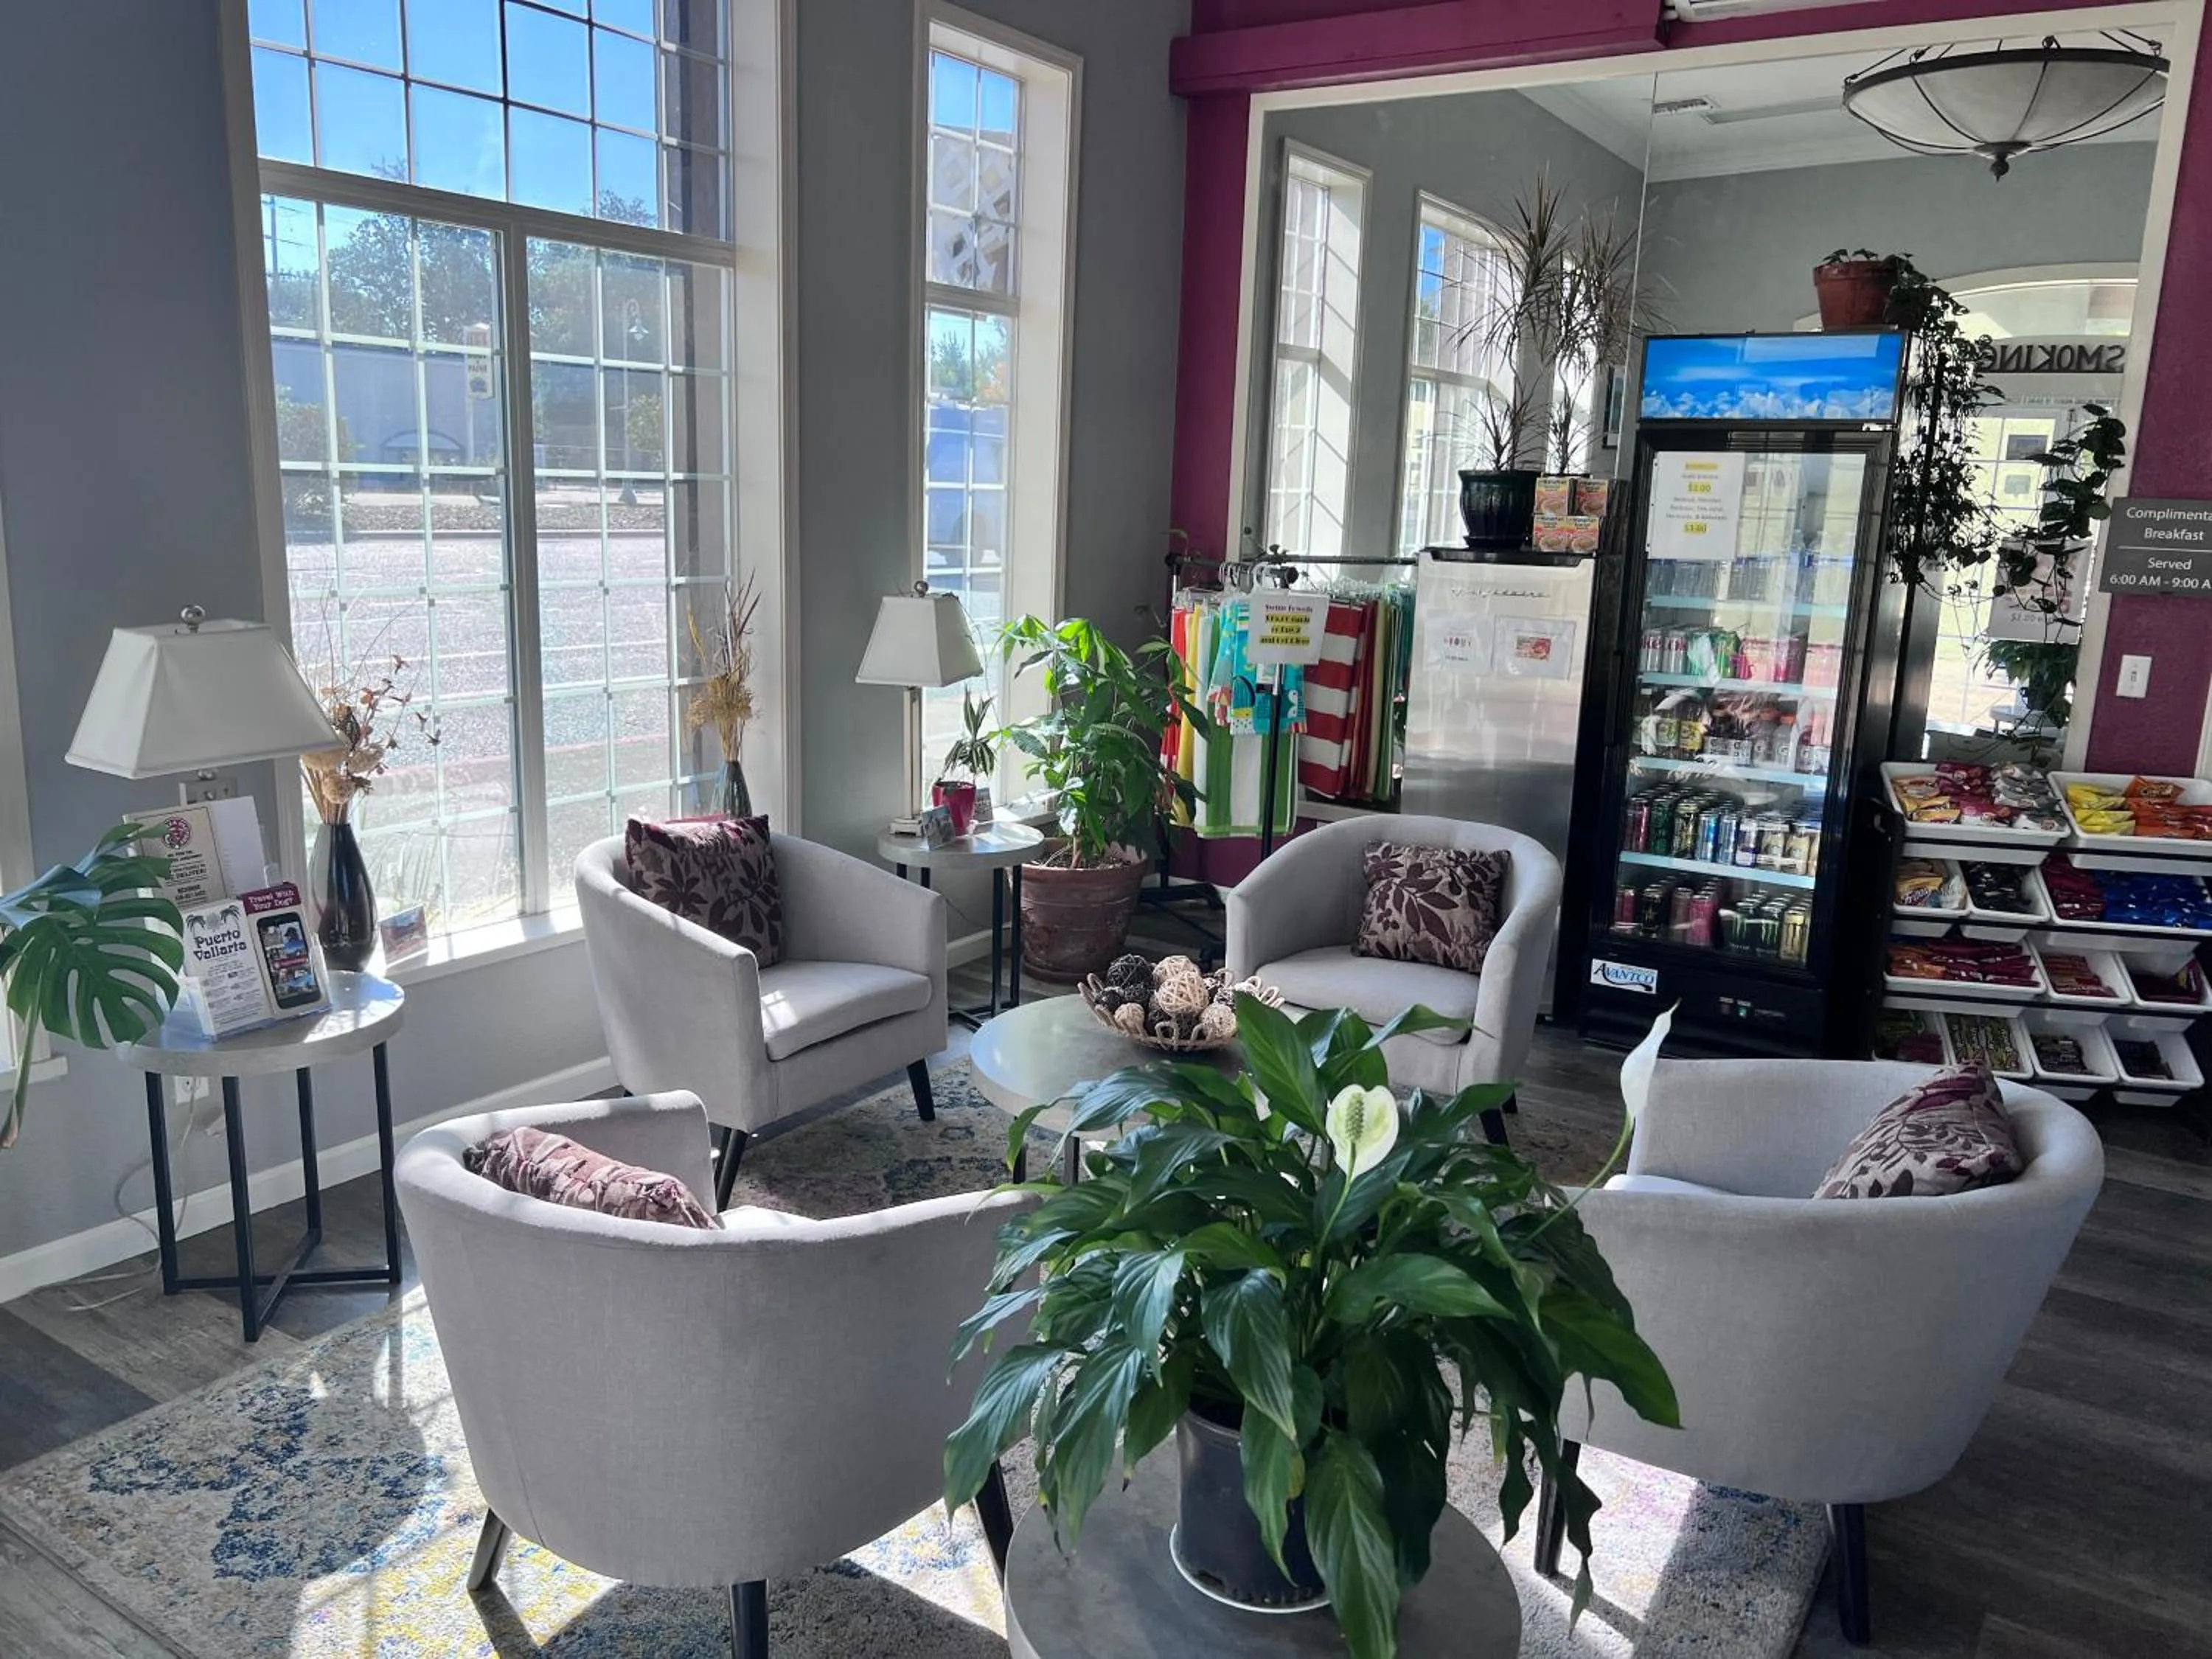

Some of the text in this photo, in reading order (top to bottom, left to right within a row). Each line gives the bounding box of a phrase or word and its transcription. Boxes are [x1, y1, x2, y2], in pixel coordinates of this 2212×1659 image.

[2144, 527, 2205, 540] Breakfast
[2147, 557, 2192, 570] Served
[2110, 574, 2136, 585] 6:00
[2139, 575, 2161, 586] AM
[2171, 577, 2199, 588] 9:00
[194, 930, 240, 949] Puerto
[193, 942, 247, 961] Vallarta
